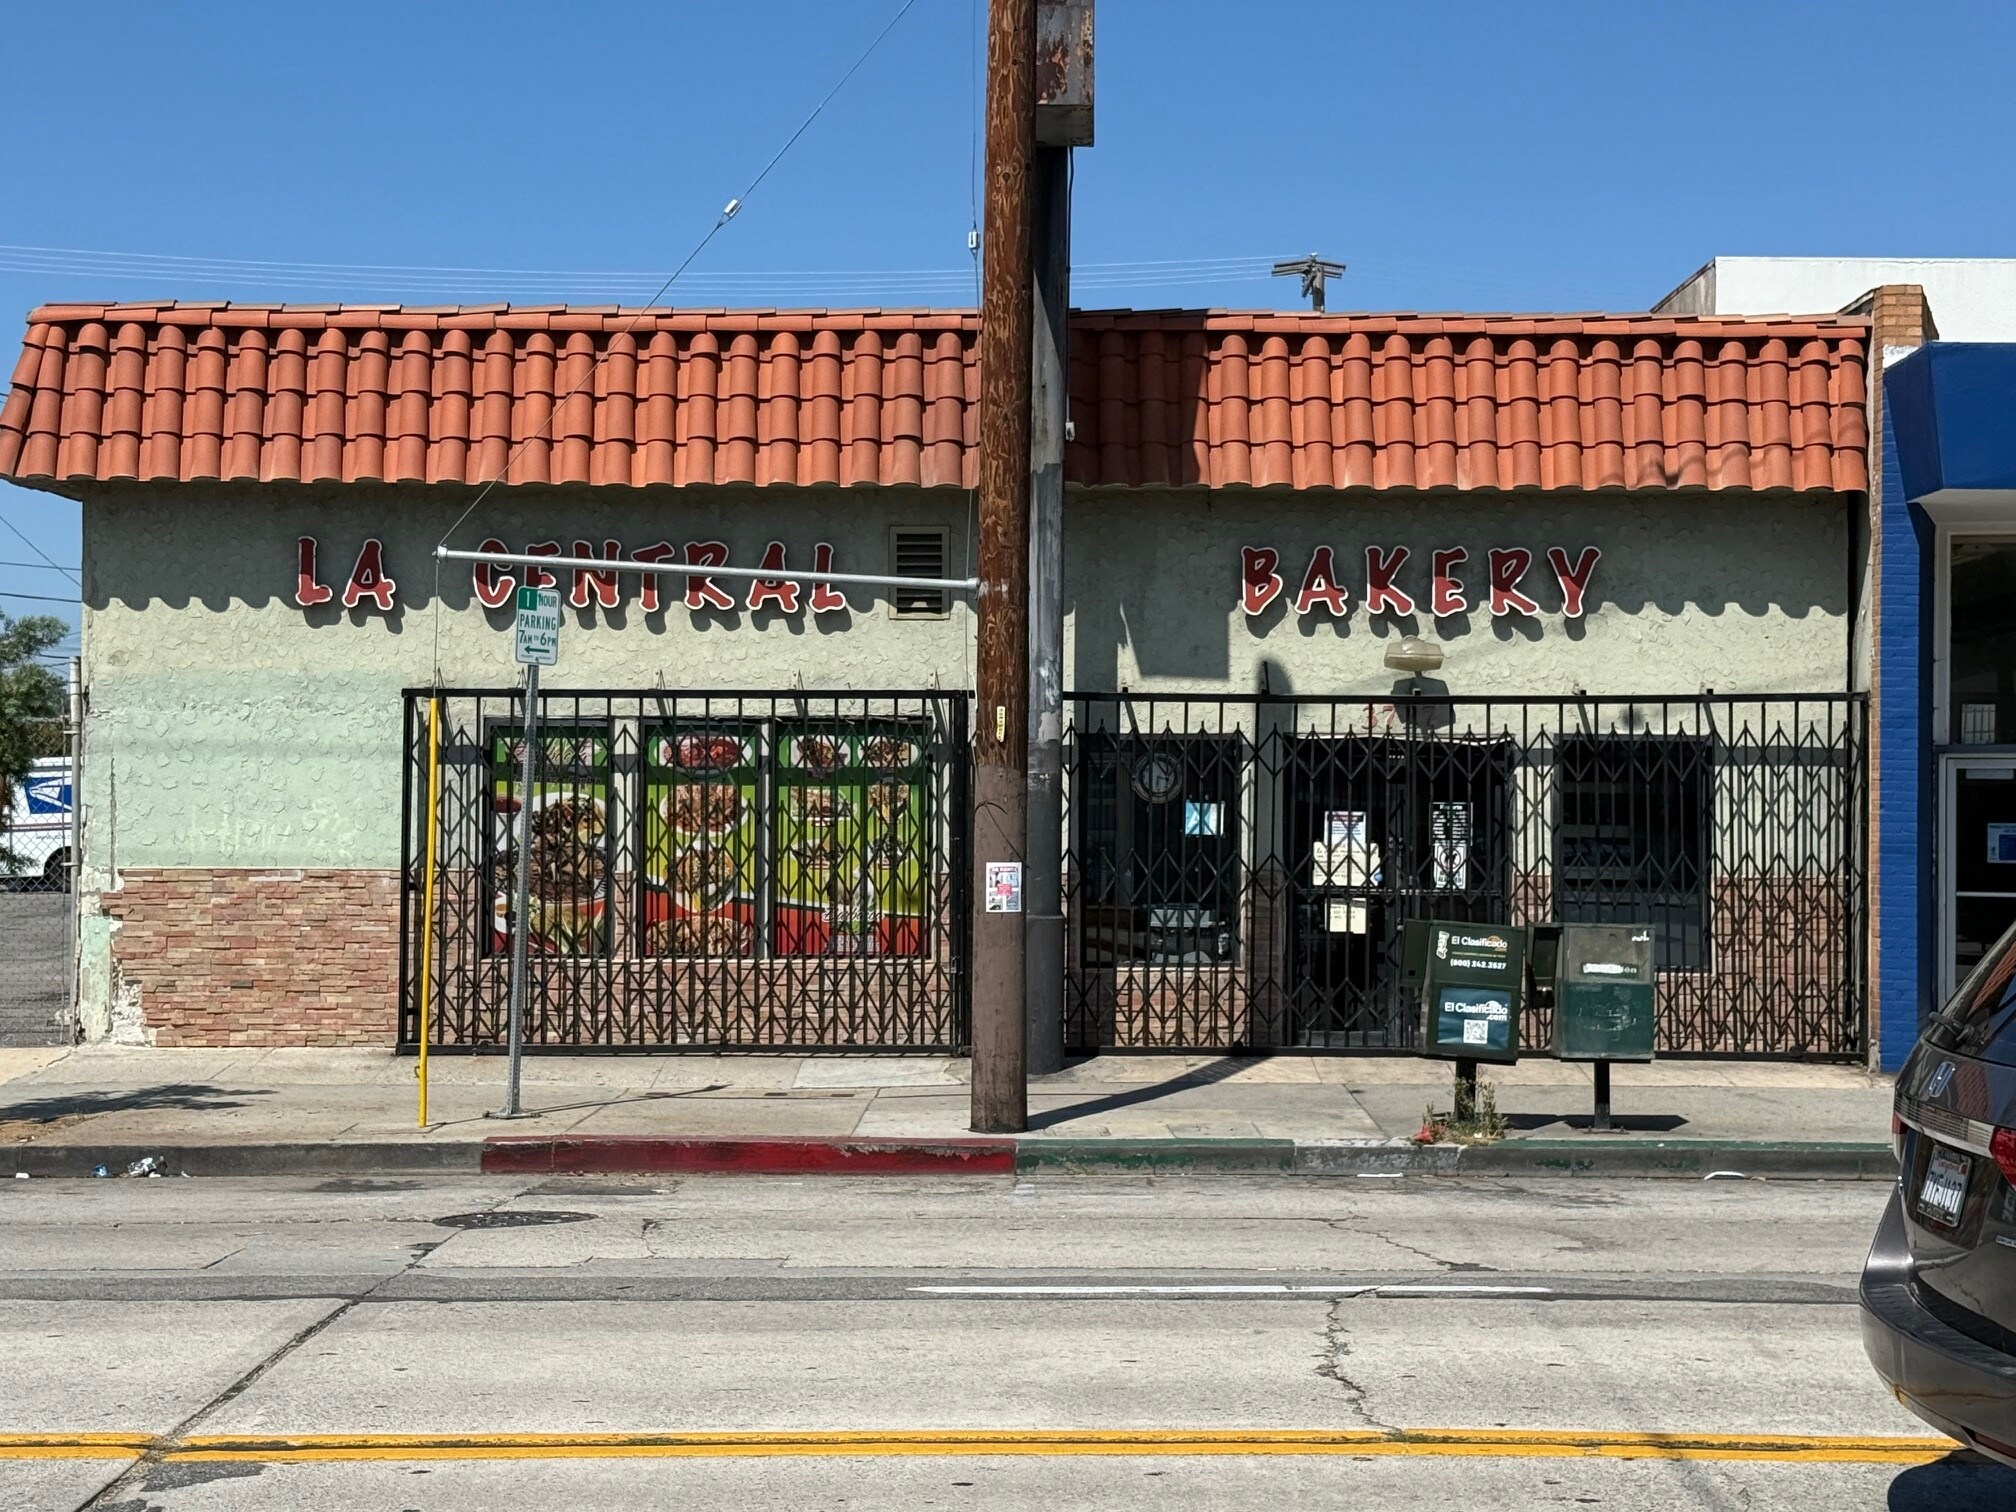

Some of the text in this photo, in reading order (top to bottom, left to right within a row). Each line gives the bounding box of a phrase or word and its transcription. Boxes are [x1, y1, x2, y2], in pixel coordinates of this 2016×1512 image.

[295, 536, 847, 613] LA CENTRAL
[1242, 545, 1601, 618] BAKERY
[538, 593, 557, 608] HOUR
[520, 613, 556, 630] PARKING
[519, 629, 532, 644] 7AM
[540, 632, 556, 647] 6PM
[1451, 935, 1508, 948] El Clasificado
[1450, 959, 1470, 968] (800)
[1444, 1001, 1508, 1015] El Clasificado
[1486, 1014, 1508, 1022] .com
